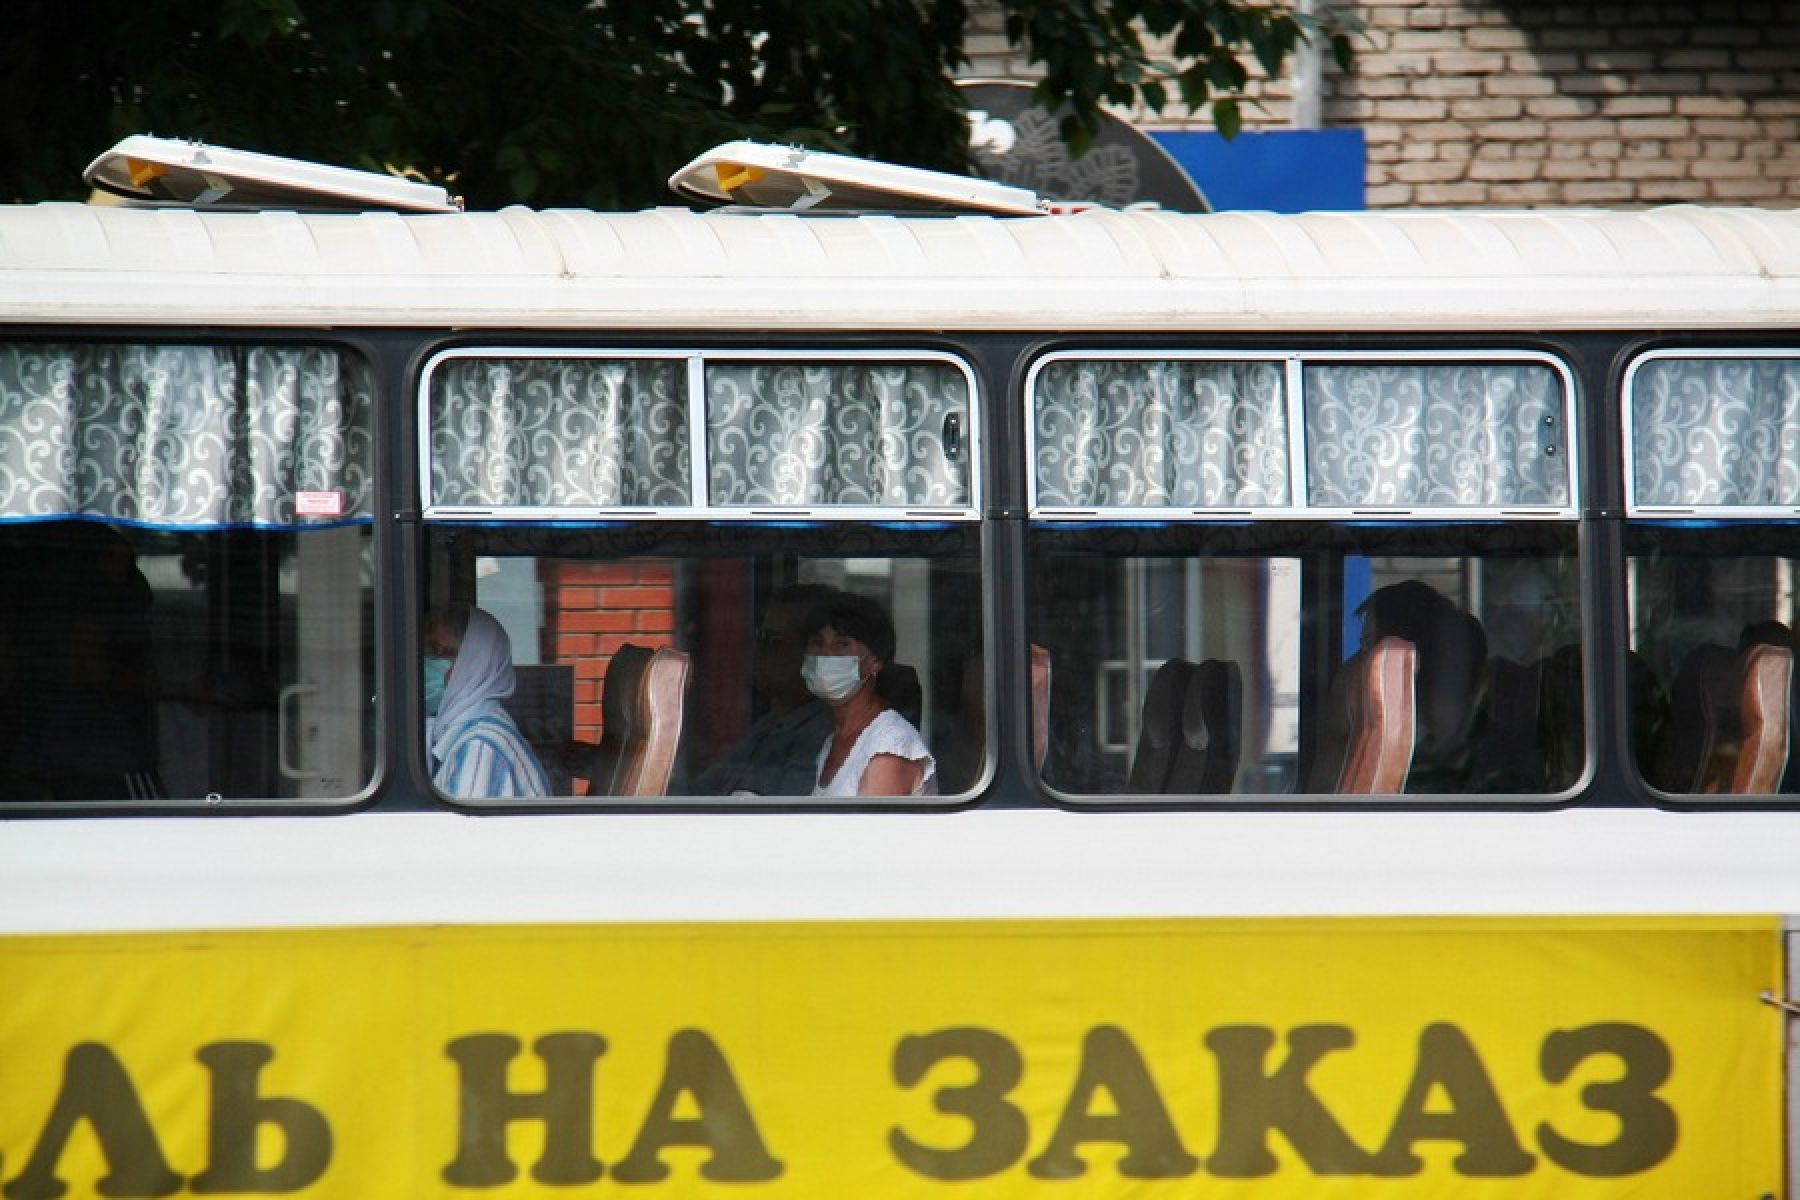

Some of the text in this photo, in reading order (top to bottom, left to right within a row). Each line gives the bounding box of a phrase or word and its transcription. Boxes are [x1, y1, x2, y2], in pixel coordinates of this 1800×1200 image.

[0, 1021, 1679, 1200] ЛЬ НА ЗАКАЗ
